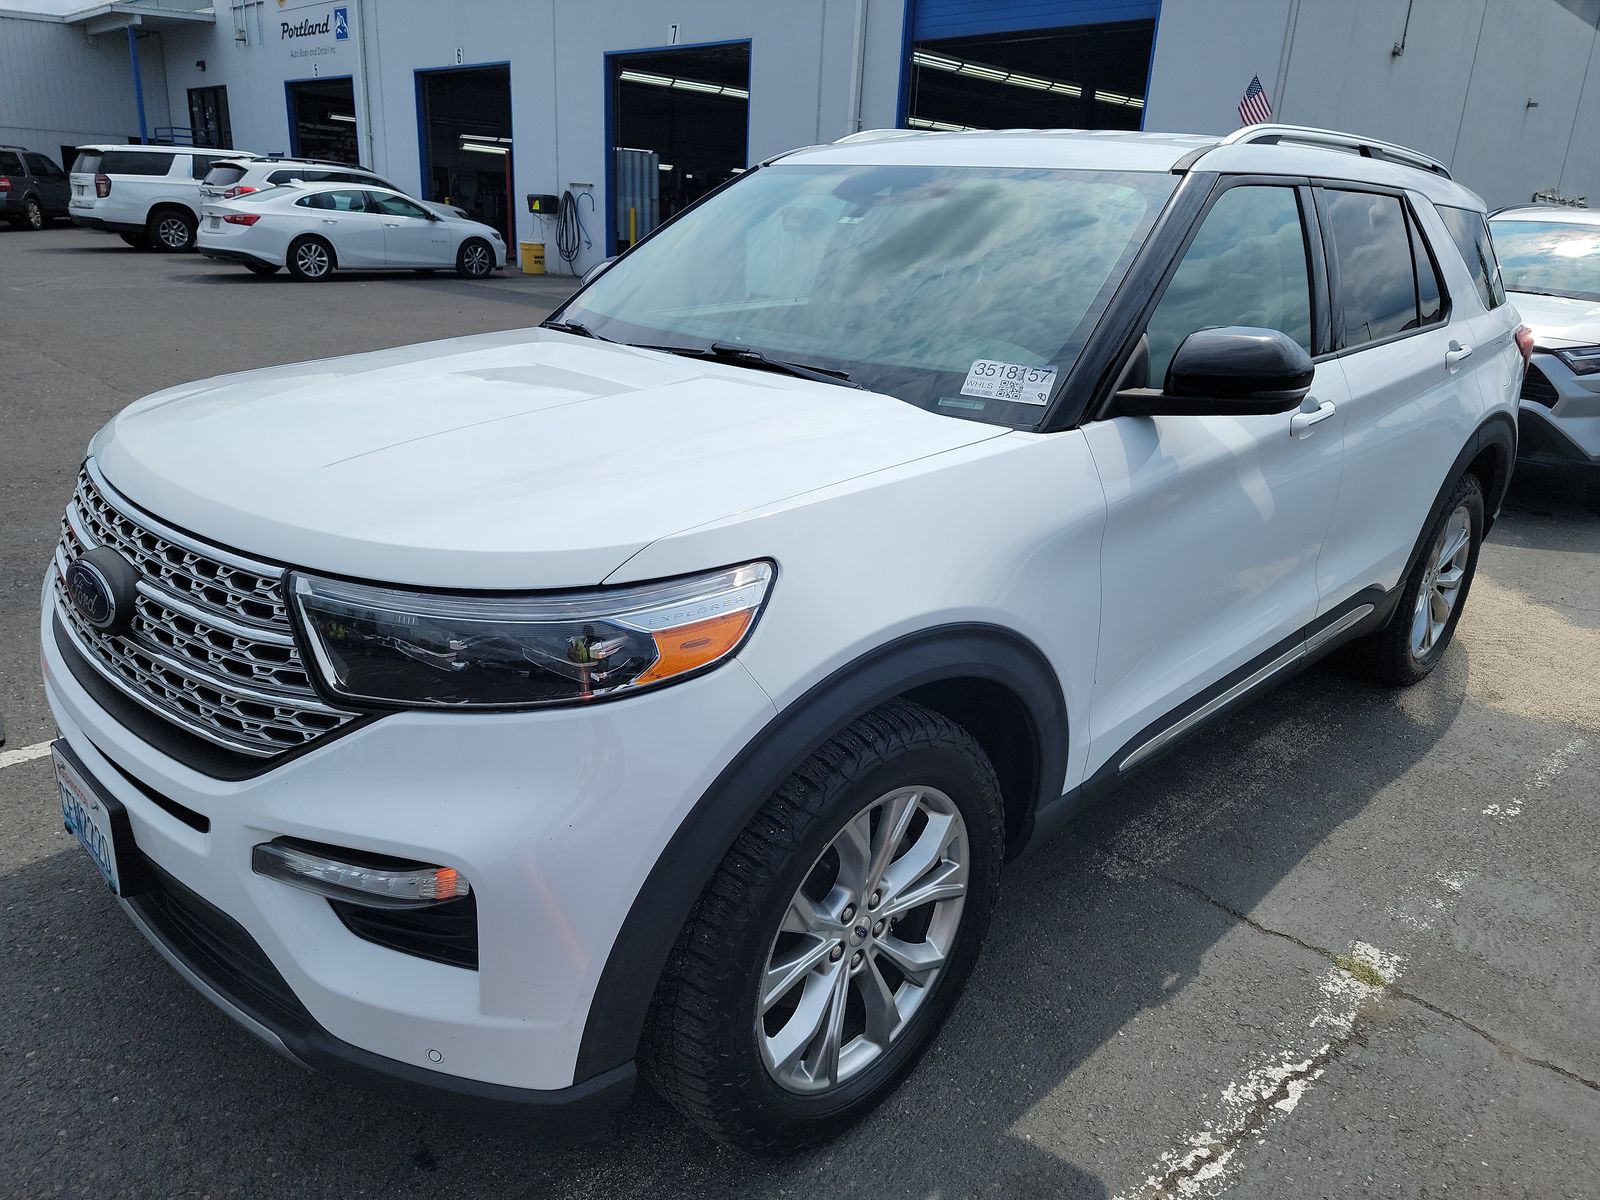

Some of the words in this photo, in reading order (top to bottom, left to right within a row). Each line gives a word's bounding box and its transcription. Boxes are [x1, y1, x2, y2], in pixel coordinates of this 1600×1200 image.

[281, 14, 330, 40] Portland
[671, 25, 678, 44] 7
[290, 50, 299, 58] Auto
[300, 49, 309, 58] Body
[317, 46, 329, 56] Detail
[457, 48, 462, 64] 6
[313, 63, 319, 77] 5
[974, 362, 1053, 384] 3518157
[966, 380, 994, 390] WHLS
[71, 572, 99, 615] Ford
[648, 596, 745, 625] EXPLORER
[59, 780, 112, 875] CEW2220
